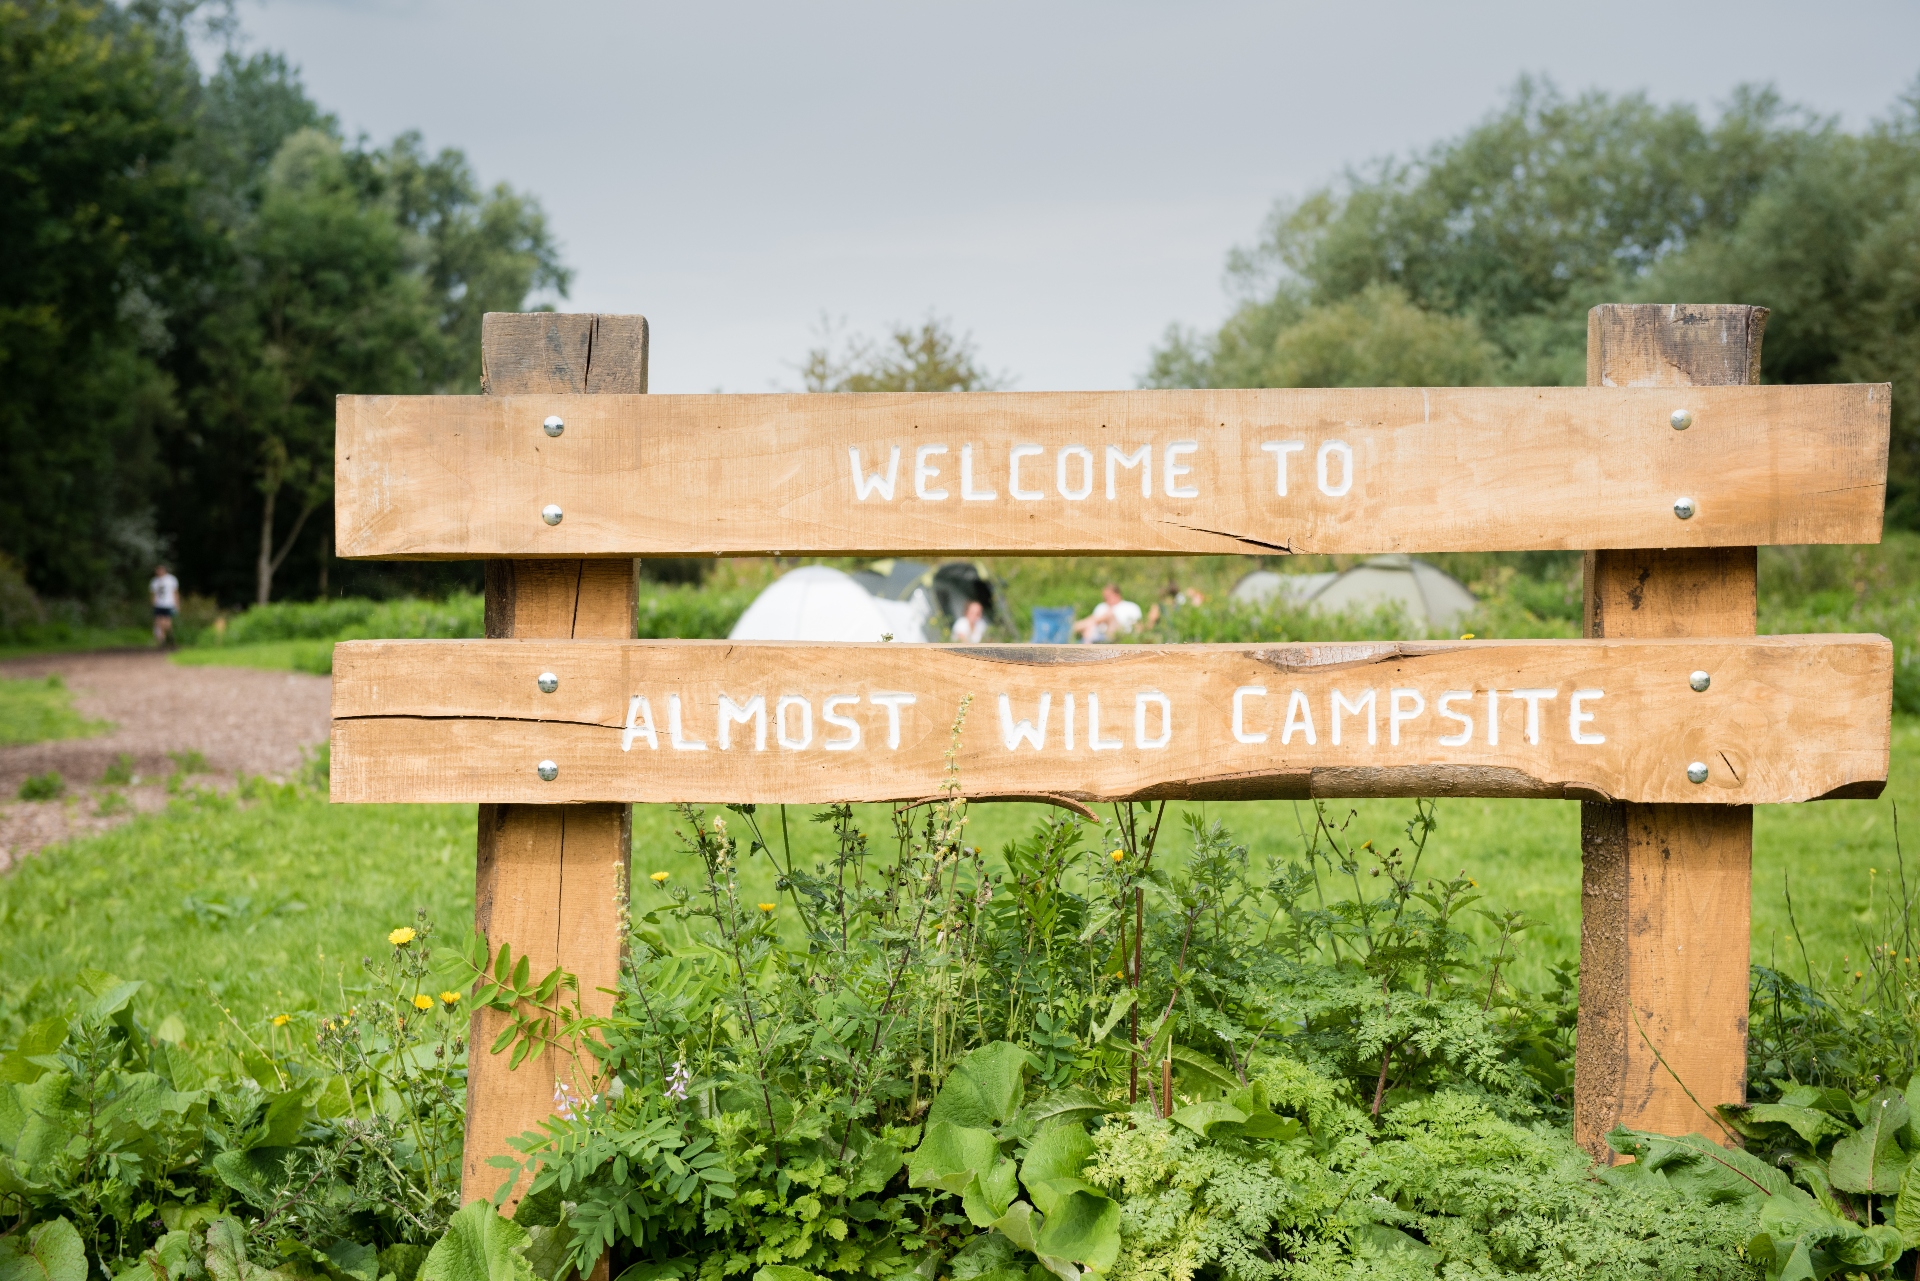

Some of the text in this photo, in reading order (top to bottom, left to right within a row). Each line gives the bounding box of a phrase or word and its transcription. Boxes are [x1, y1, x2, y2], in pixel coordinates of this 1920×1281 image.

[848, 439, 1354, 502] WELCOME TO
[621, 685, 1606, 753] ALMOST WILD CAMPSITE
